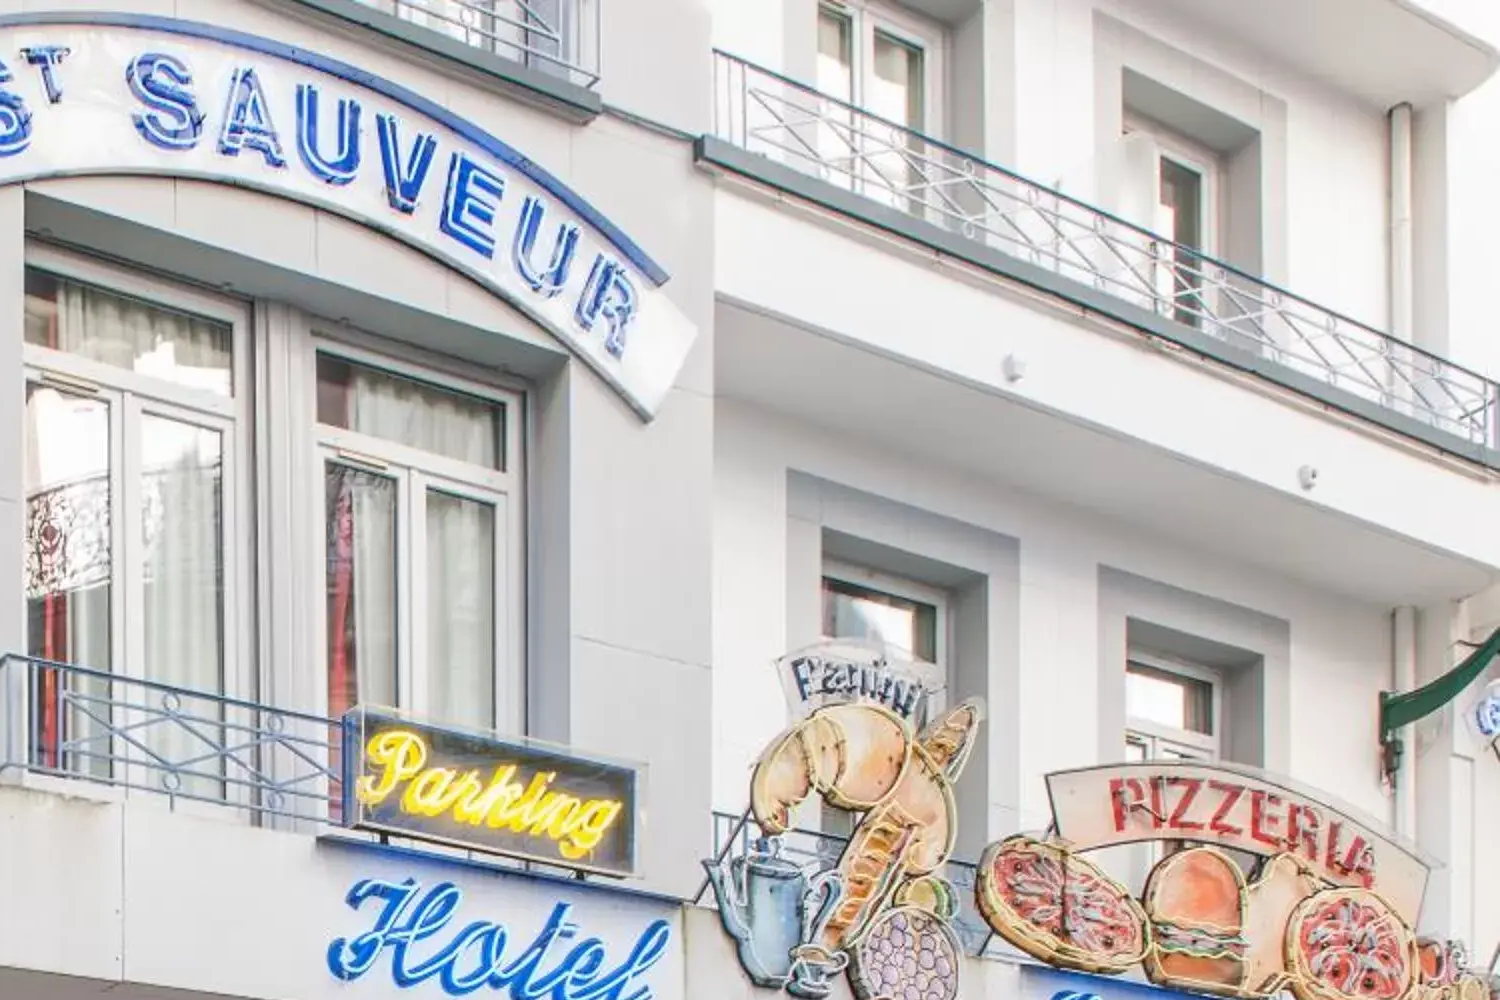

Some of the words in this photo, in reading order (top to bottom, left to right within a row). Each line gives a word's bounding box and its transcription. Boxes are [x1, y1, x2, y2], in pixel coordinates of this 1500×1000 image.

[125, 52, 642, 359] SAUVEUR
[355, 731, 623, 859] Parking
[1108, 775, 1377, 890] PIZZERIA
